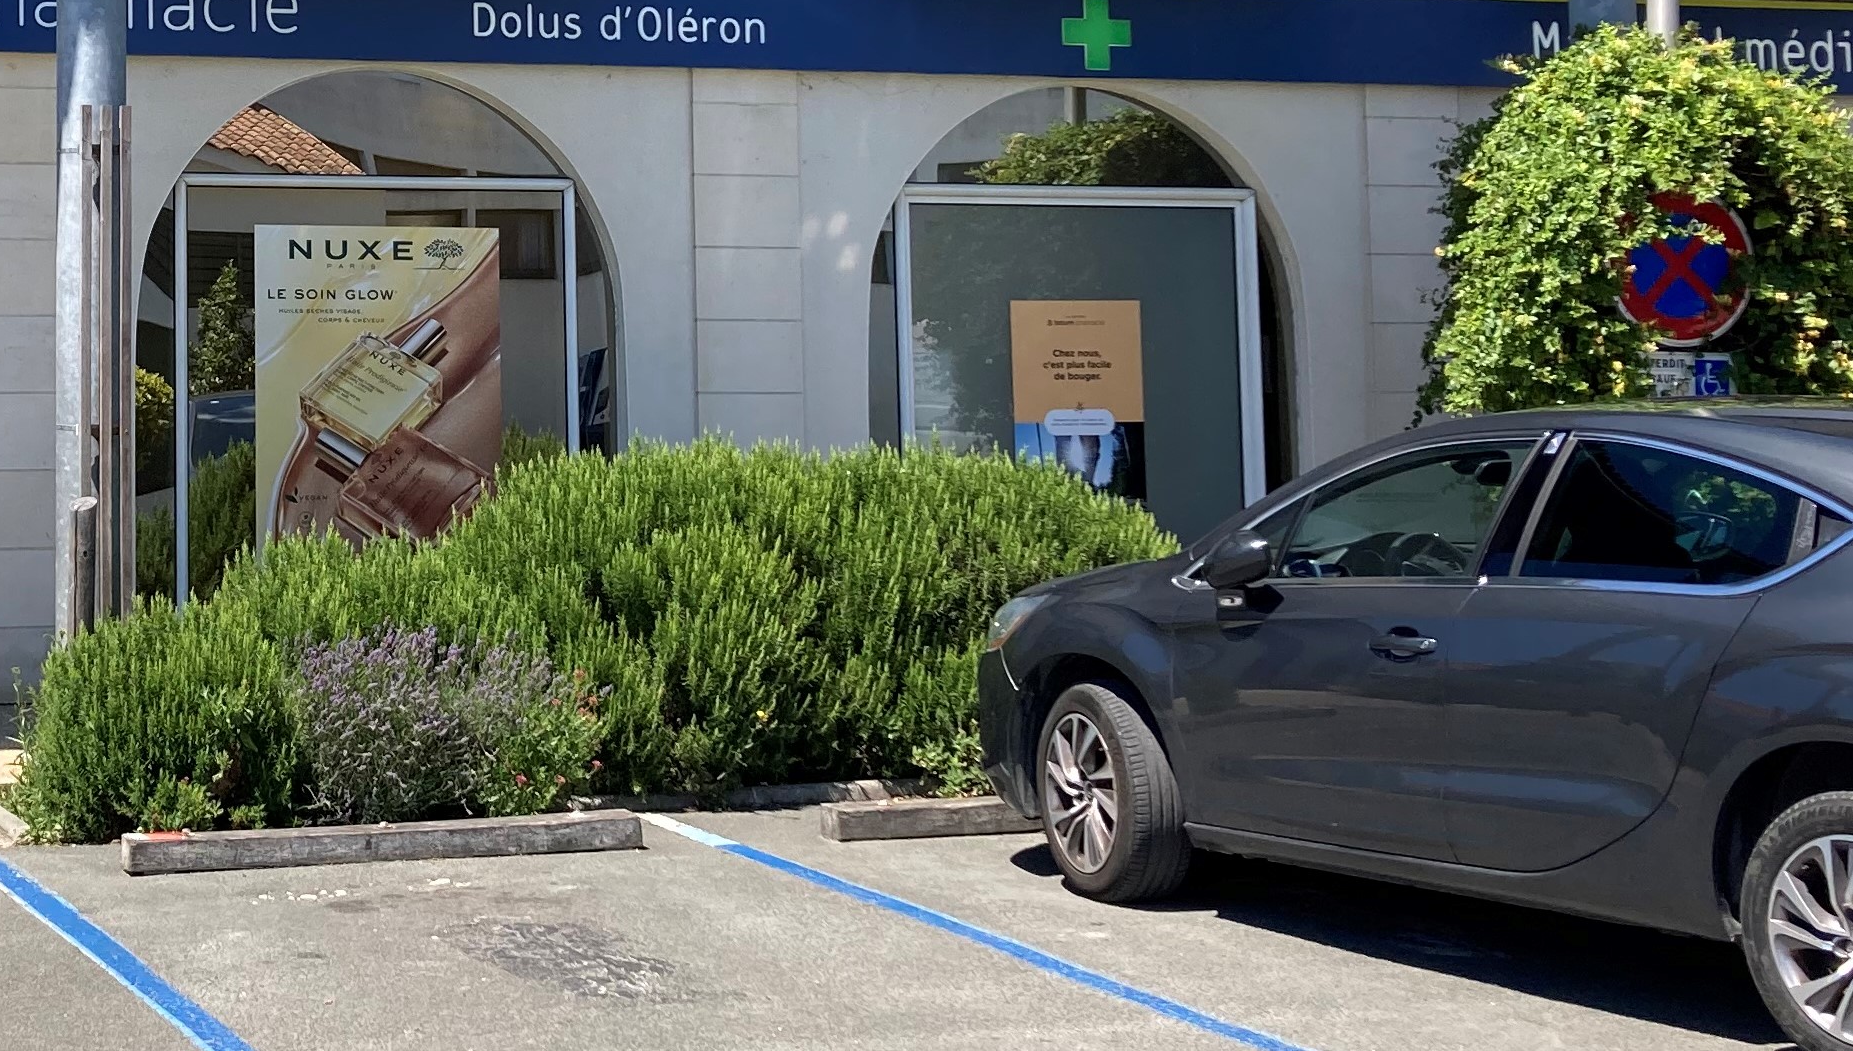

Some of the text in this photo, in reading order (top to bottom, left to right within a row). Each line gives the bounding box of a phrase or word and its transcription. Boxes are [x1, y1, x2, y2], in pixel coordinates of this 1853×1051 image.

[472, 2, 582, 40] Dolus
[288, 239, 414, 261] NUXE
[268, 289, 287, 299] LE
[294, 289, 335, 300] SOIN
[368, 350, 408, 376] NUXE
[1053, 349, 1102, 358] Chez nous,
[1067, 361, 1085, 370] plus
[368, 446, 404, 484] NUXE
